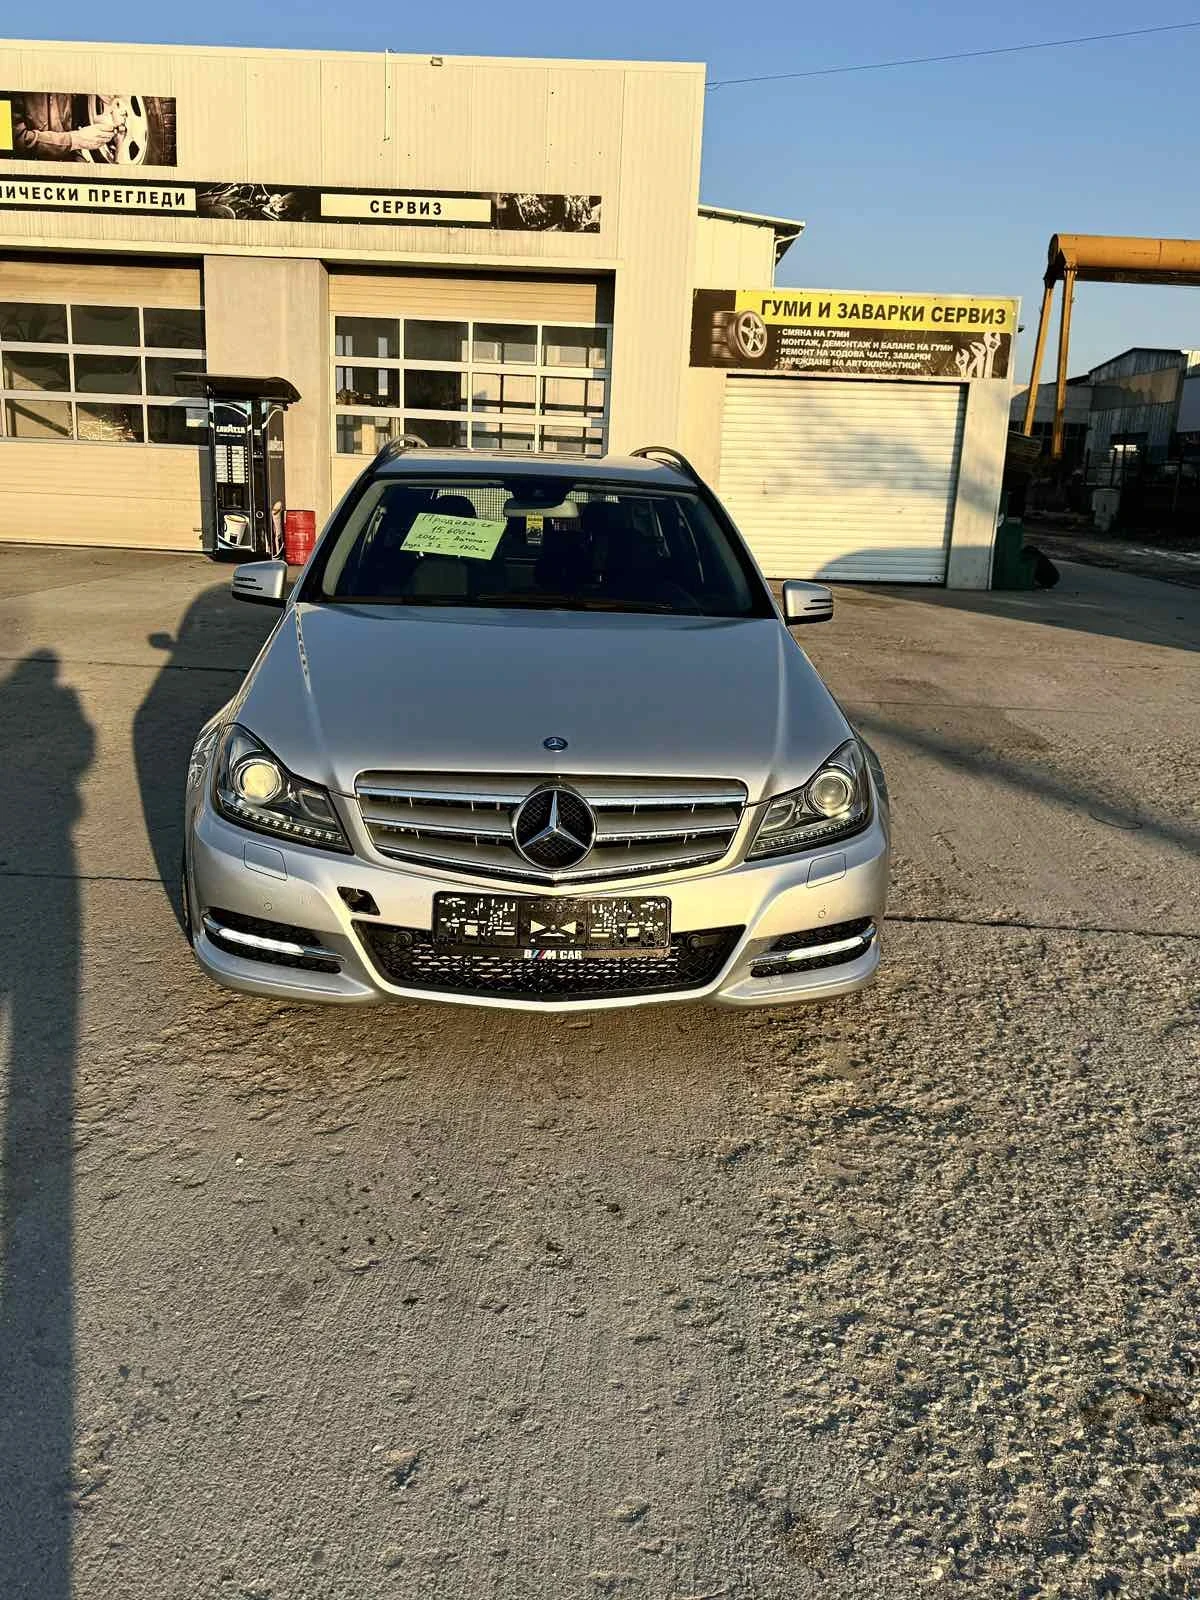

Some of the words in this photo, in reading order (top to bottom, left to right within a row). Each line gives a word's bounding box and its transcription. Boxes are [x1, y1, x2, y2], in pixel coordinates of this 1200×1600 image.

[0, 185, 79, 202] ИЧЕСКИ
[88, 189, 186, 208] ПРЕГЛЕДИ
[369, 200, 442, 216] СЕРВИЗ
[761, 299, 812, 317] ГУМИ
[818, 301, 831, 318] И
[837, 302, 925, 322] ЗАВАРКИ
[931, 306, 1006, 325] СЕРВИЗ
[782, 328, 812, 338] СМЯНА
[813, 330, 827, 338] НА
[827, 330, 850, 338] ГУМИ
[822, 339, 871, 350] ДЕМОНТАЖ
[881, 341, 916, 351] БАЛАНС
[917, 343, 929, 352] НА
[930, 343, 954, 352] ГУМИ
[780, 347, 815, 357] РЕМОНТ
[816, 349, 829, 358] НА
[830, 349, 865, 360] ХОДОВА
[893, 351, 932, 361] ЗАВАРКИ
[559, 949, 583, 960] CAR
